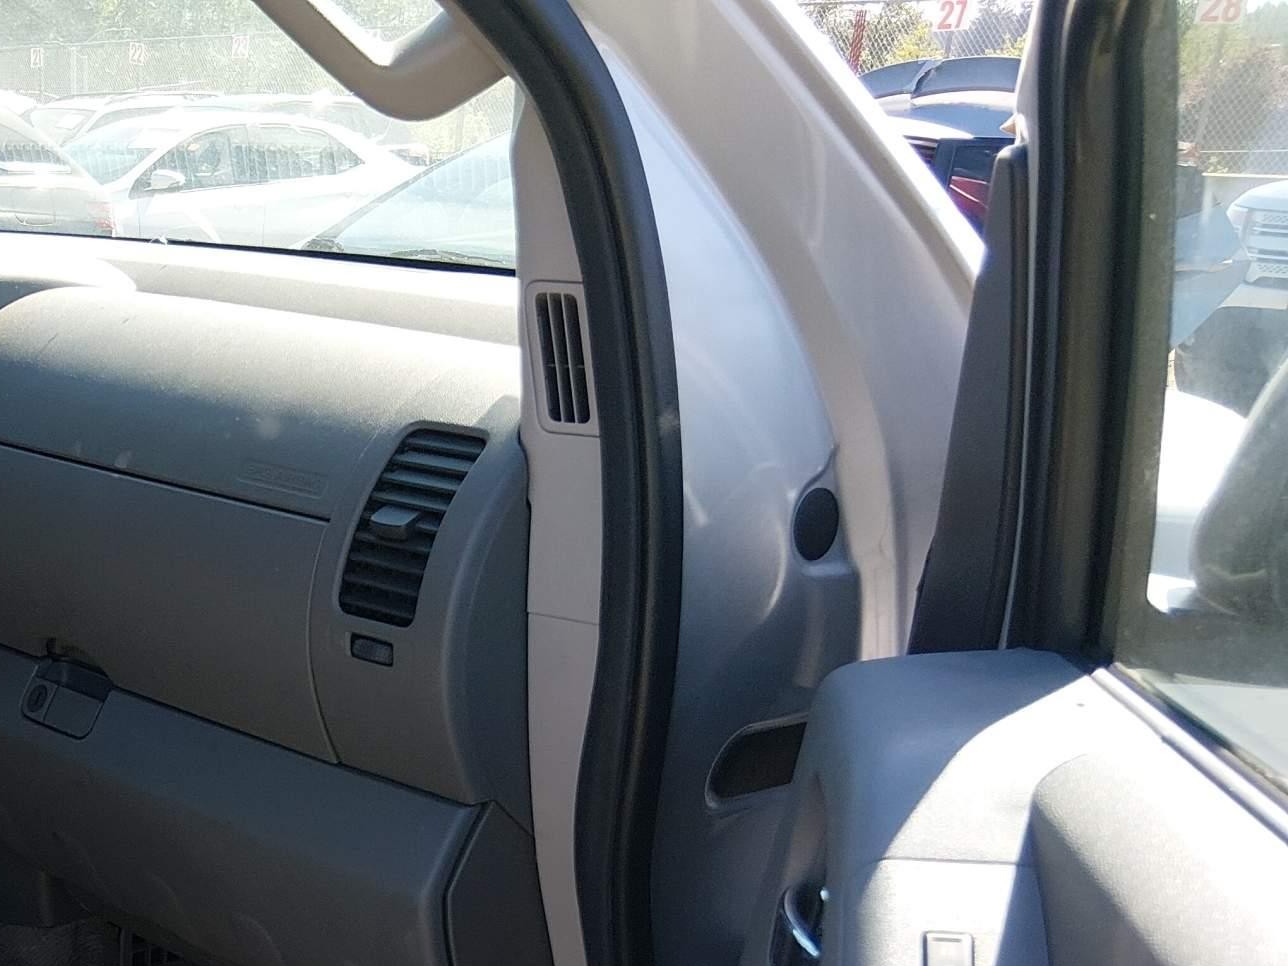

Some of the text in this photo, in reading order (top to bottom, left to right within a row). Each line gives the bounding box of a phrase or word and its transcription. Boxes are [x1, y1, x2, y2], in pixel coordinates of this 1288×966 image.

[937, 0, 968, 29] 27
[1199, 0, 1241, 22] 28
[129, 43, 144, 64] 22
